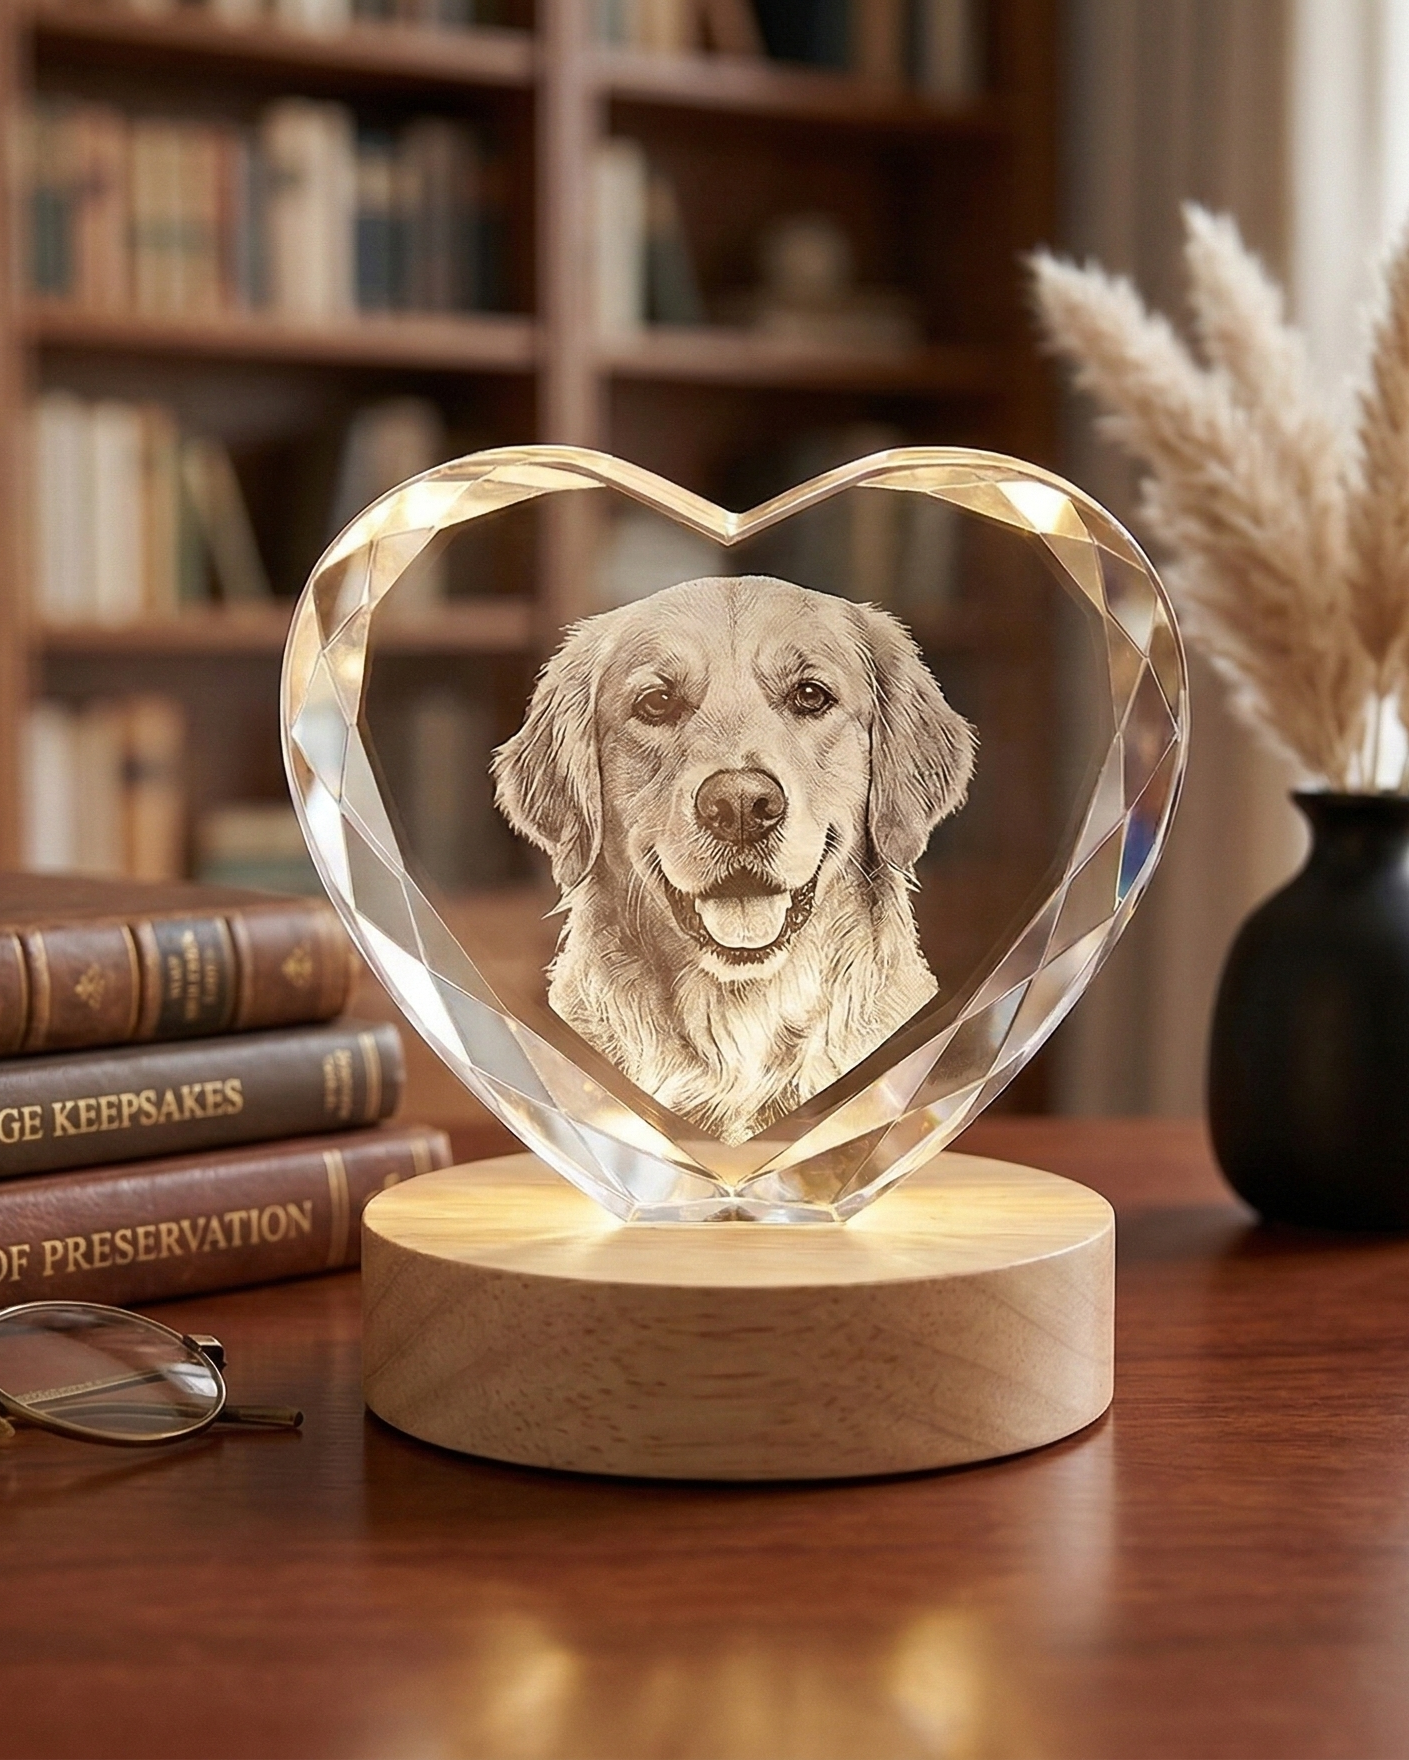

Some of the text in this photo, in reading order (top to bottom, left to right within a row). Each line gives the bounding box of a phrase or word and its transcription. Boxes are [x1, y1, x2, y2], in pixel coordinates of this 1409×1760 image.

[52, 1078, 244, 1137] KEEPSAKES
[0, 1200, 313, 1281] F PRESERVATION
